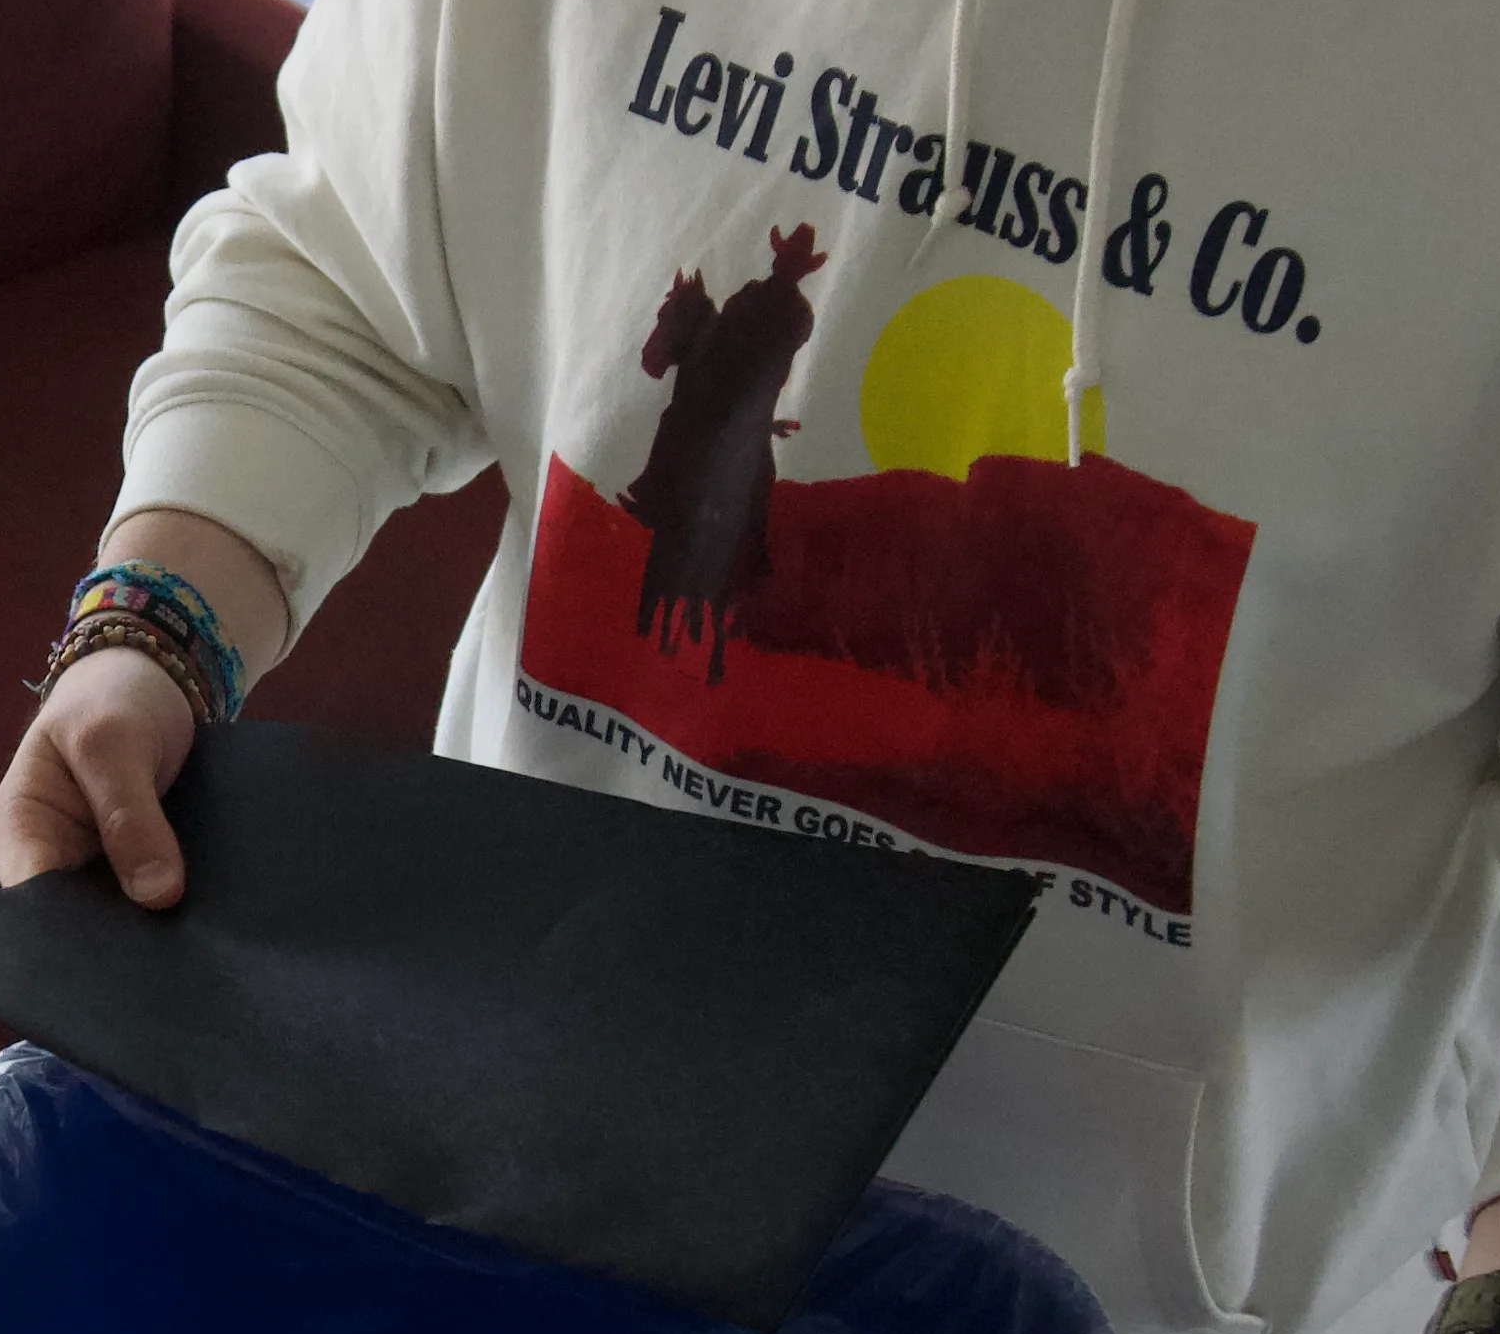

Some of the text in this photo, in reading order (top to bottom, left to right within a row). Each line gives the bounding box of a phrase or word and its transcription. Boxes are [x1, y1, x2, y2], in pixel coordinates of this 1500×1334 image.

[627, 5, 1321, 345] Levi Strauss & Co.
[515, 677, 657, 767] QUALITY
[662, 753, 784, 826] NEVER
[1068, 878, 1192, 948] STYLE
